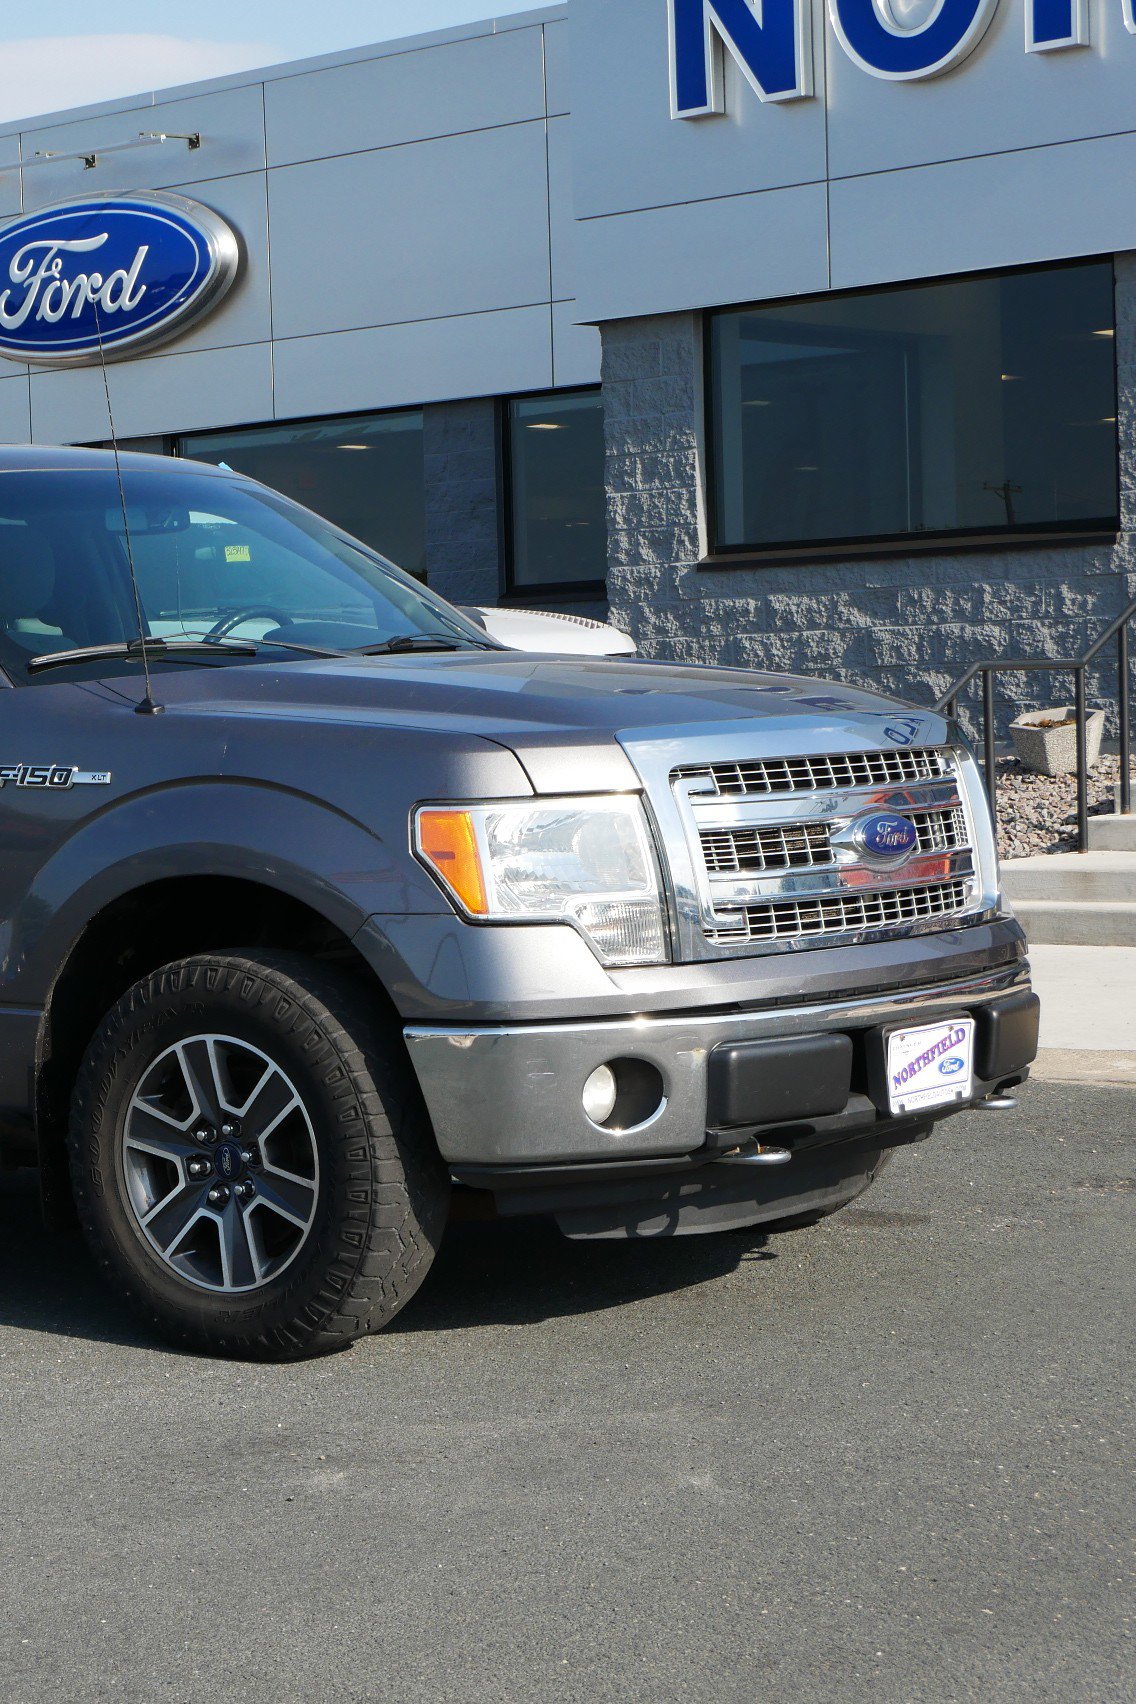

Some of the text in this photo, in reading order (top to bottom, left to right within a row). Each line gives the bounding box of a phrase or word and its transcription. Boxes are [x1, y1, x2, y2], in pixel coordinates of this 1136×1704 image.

[875, 821, 910, 848] Ford
[893, 1027, 966, 1091] NORTHFIELD
[941, 1059, 962, 1073] Ford
[222, 1149, 232, 1174] Ford
